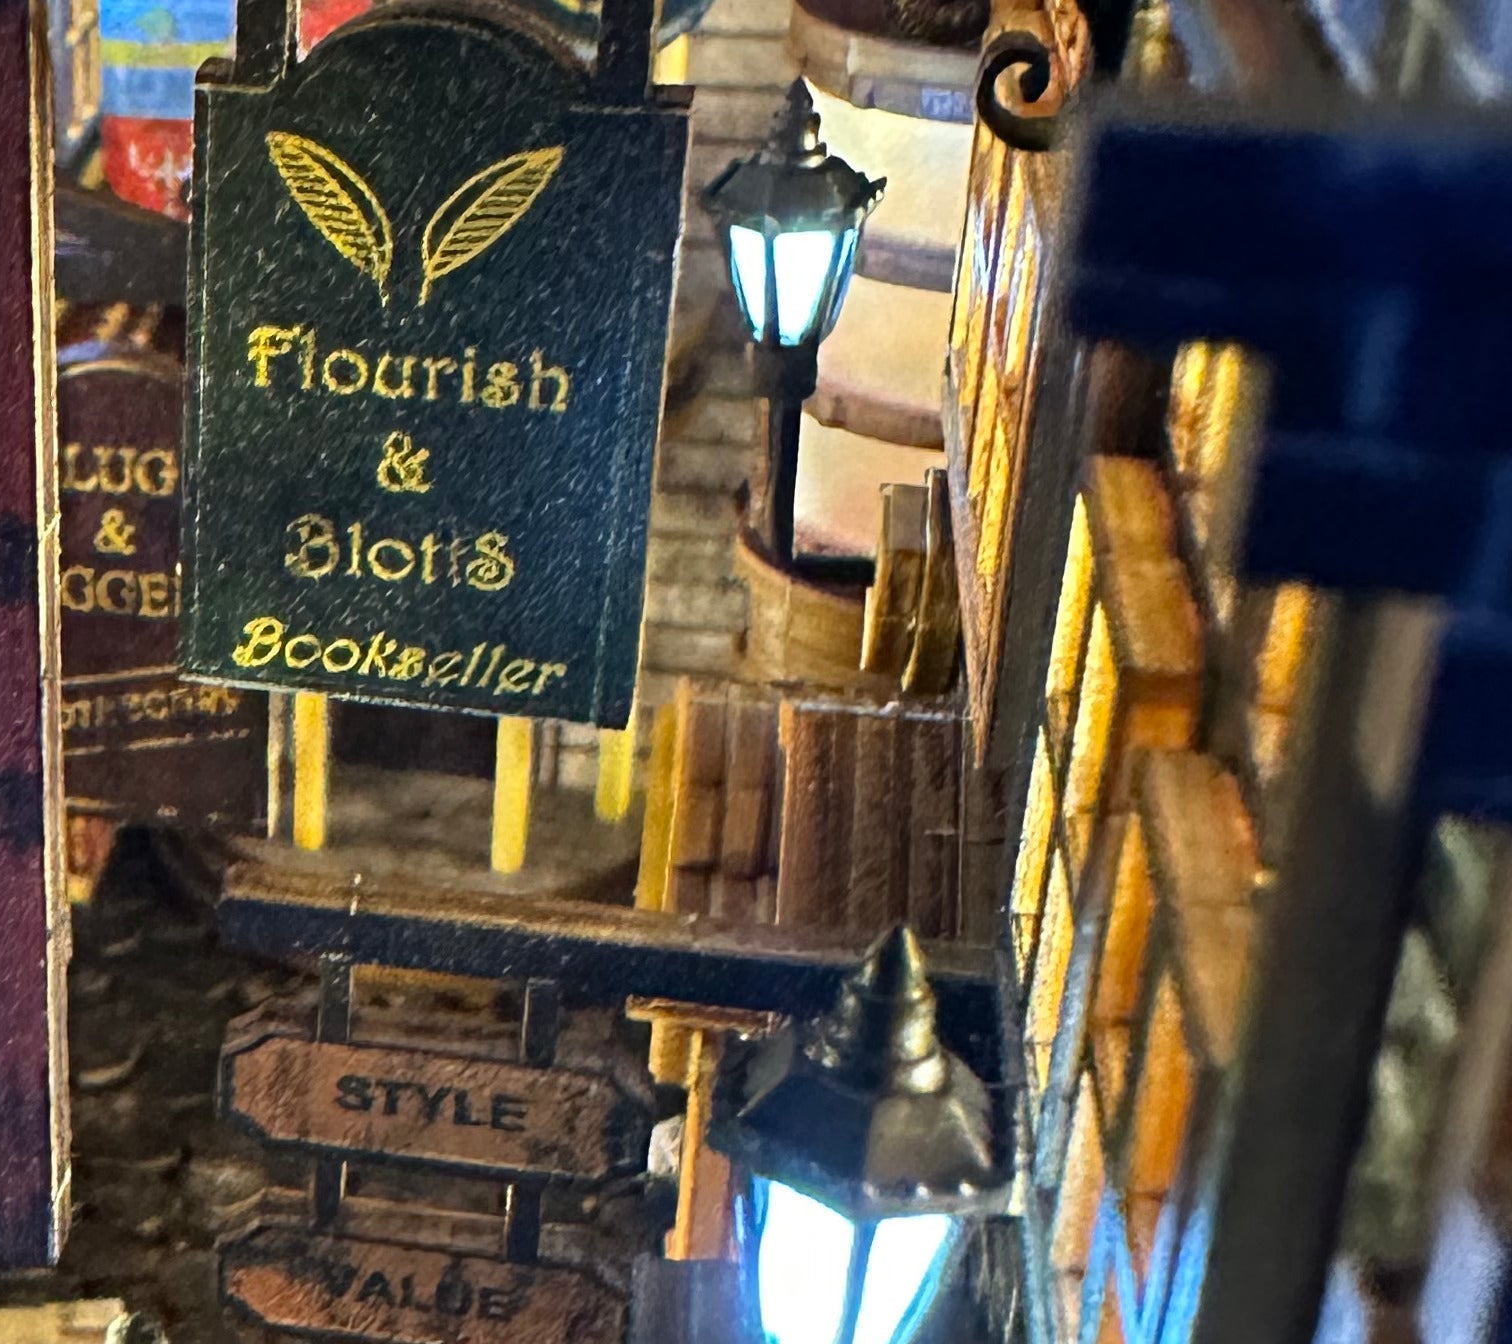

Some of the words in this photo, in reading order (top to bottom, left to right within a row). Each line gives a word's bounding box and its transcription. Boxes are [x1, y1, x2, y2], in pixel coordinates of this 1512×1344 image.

[245, 323, 574, 413] Flourish
[376, 429, 434, 494] &
[93, 507, 138, 556] &
[284, 512, 515, 591] Blotts
[60, 565, 182, 618] GGE
[232, 616, 568, 696] Bookseller
[335, 1073, 529, 1132] STYLE
[320, 1263, 518, 1322] VALUE
